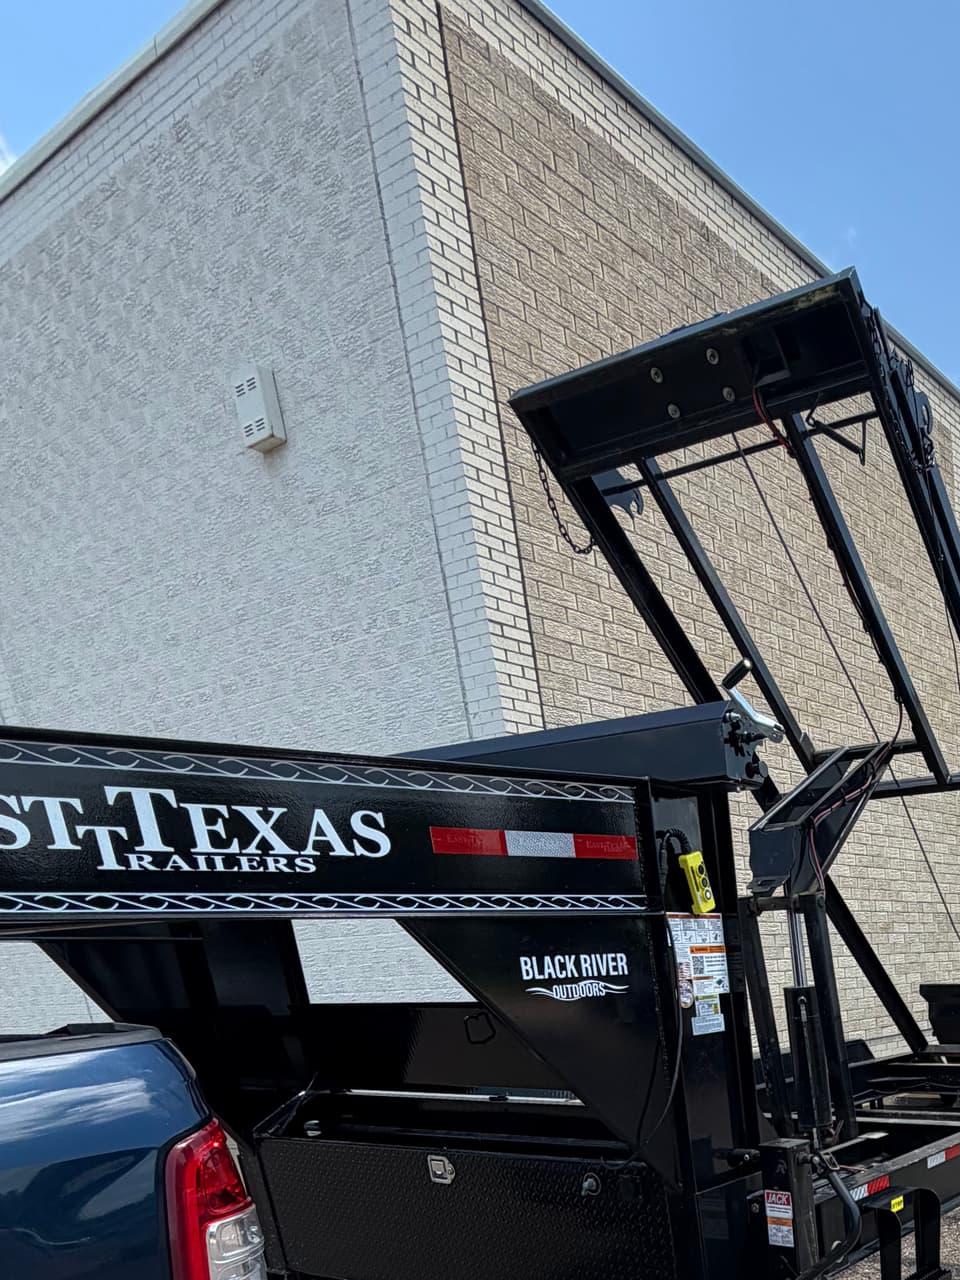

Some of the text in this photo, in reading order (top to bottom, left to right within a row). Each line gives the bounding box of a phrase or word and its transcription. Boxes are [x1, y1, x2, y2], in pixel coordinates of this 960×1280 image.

[104, 786, 392, 858] TEXAS
[76, 825, 317, 873] TRAILERS
[519, 952, 629, 981] BLACK RIVER
[552, 983, 606, 999] OUTDOORS
[767, 1192, 789, 1205] JACK
